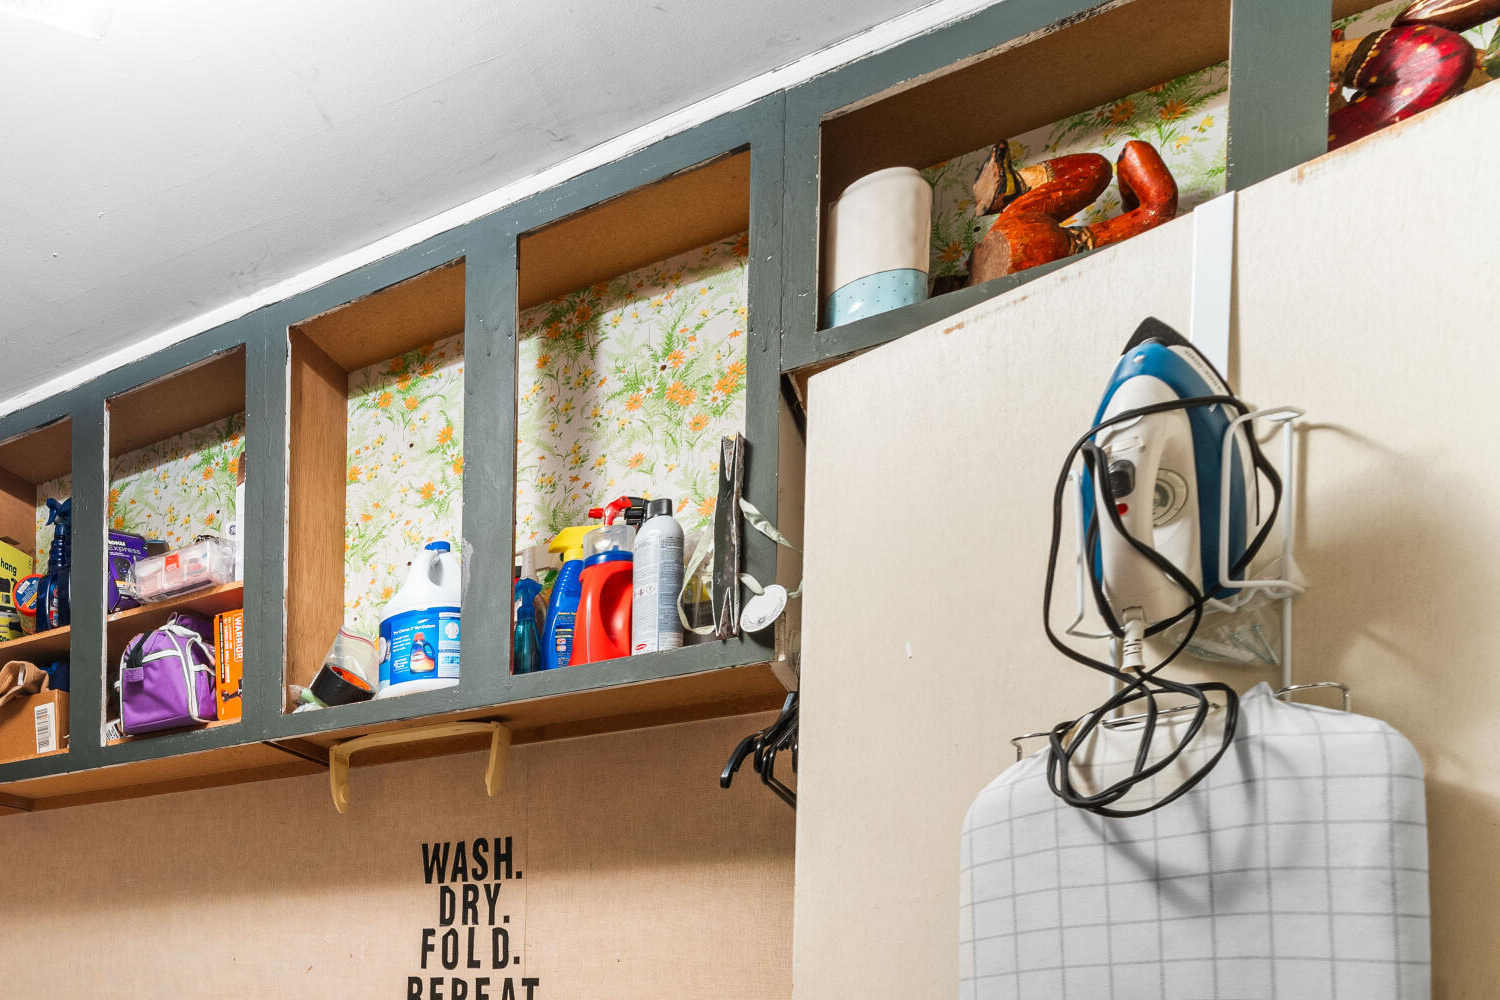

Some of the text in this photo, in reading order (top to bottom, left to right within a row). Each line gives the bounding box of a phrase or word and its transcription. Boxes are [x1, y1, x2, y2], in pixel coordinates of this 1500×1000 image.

[0, 557, 18, 577] hang
[108, 545, 142, 555] Express
[234, 616, 244, 660] WARRIOR
[421, 836, 523, 884] WASH.
[439, 883, 510, 927] DRY.
[421, 927, 520, 971] FOLD.
